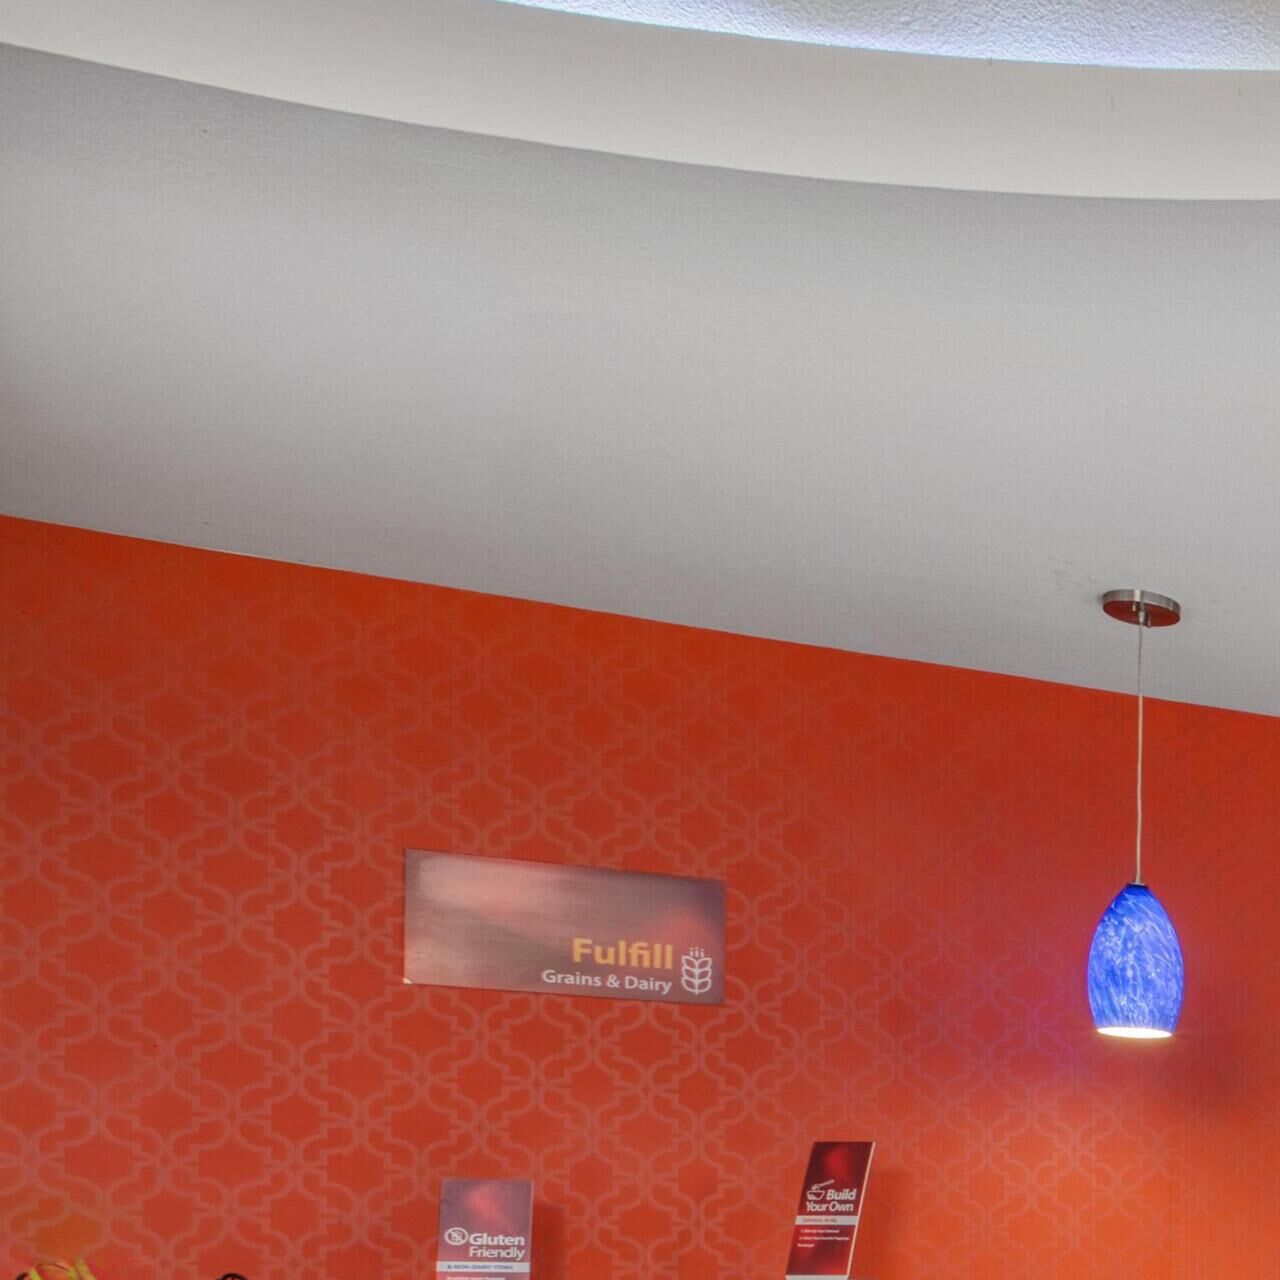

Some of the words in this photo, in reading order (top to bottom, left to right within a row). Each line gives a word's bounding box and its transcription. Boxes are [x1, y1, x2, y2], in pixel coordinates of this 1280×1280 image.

[573, 938, 673, 969] Fulfill
[541, 969, 602, 987] Grains
[606, 974, 620, 988] &
[624, 975, 672, 995] Dairy
[826, 1188, 857, 1200] Build
[806, 1201, 828, 1212] Your
[829, 1201, 854, 1212] Own
[468, 1233, 525, 1246] Gluten
[469, 1246, 526, 1261] Friendly
